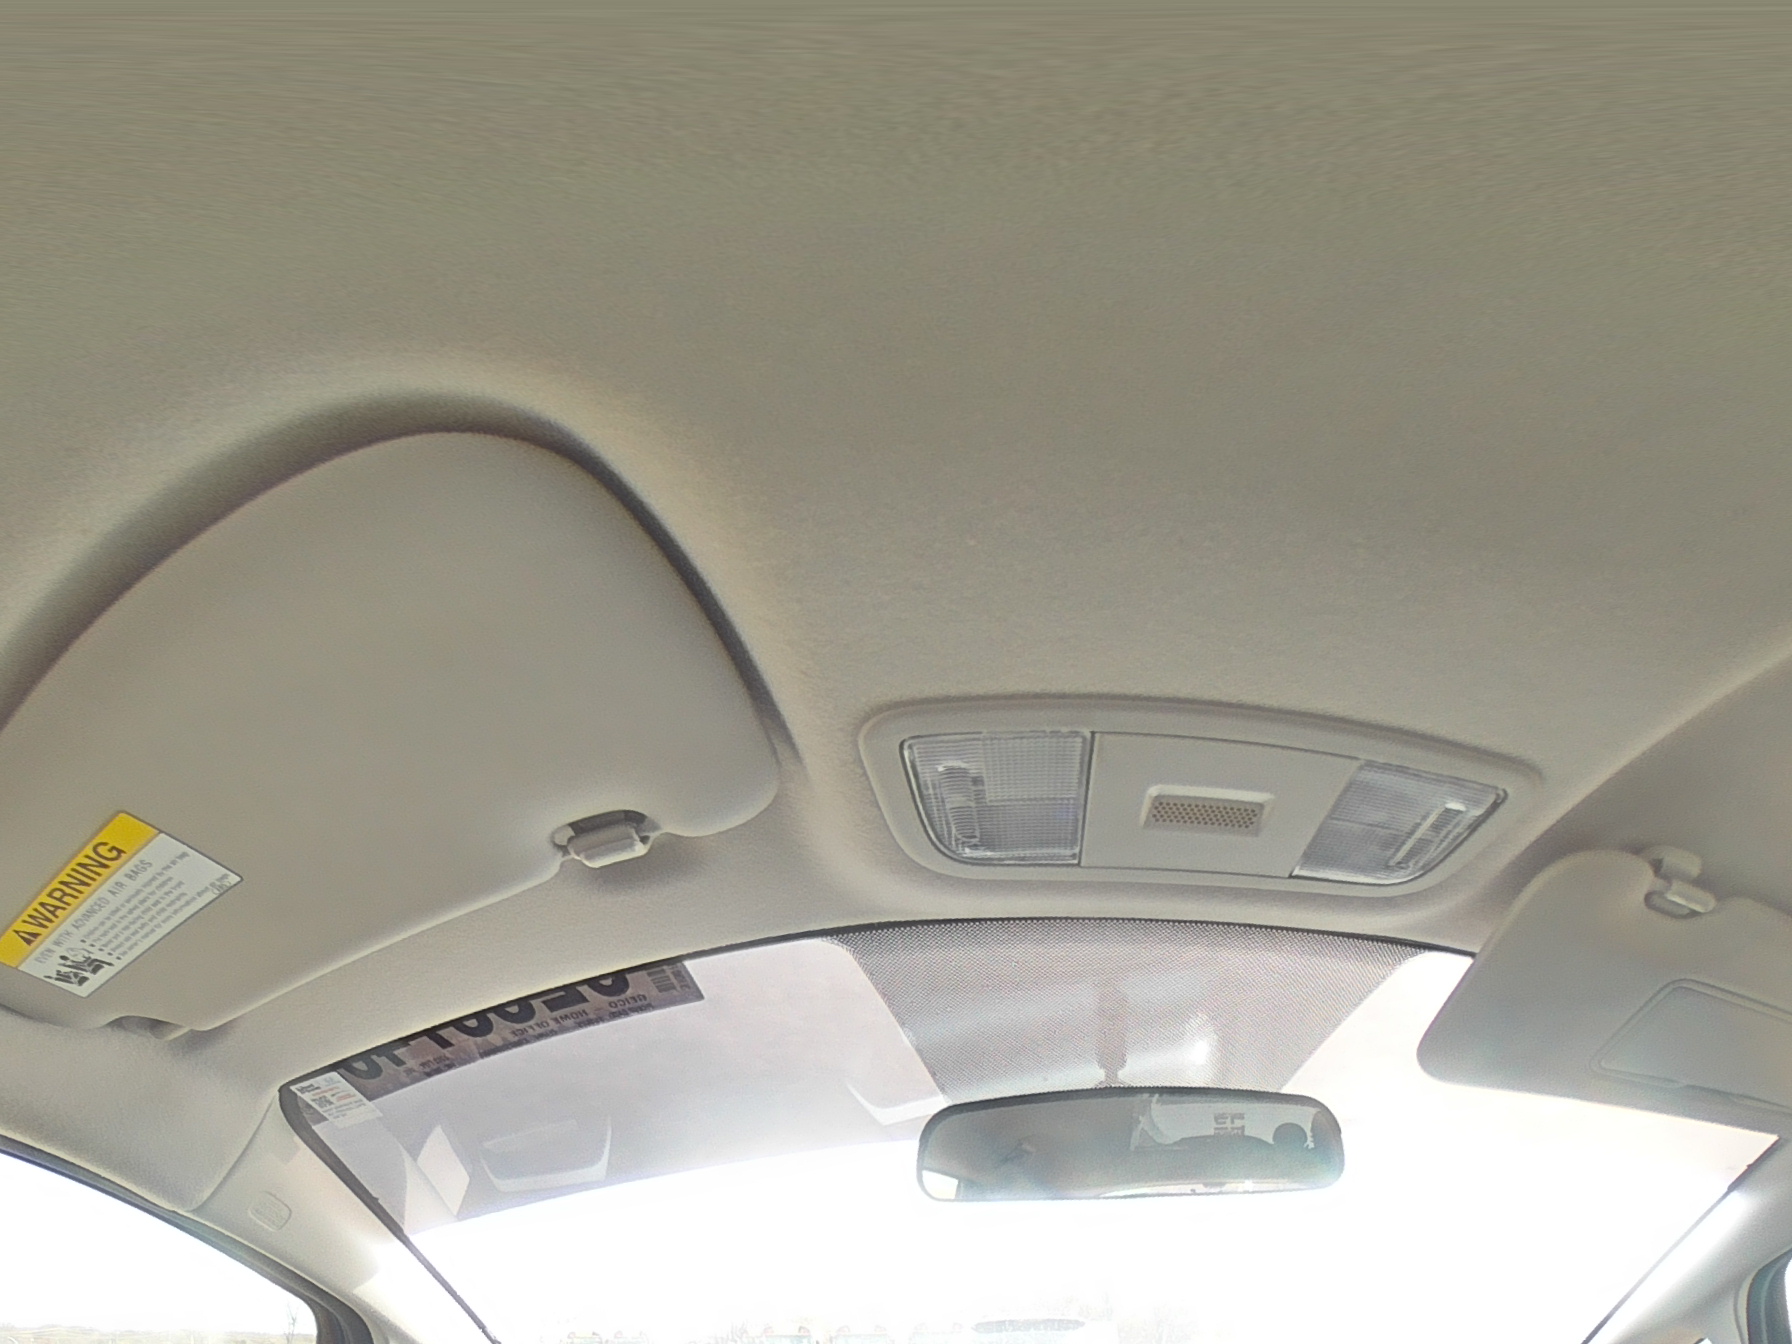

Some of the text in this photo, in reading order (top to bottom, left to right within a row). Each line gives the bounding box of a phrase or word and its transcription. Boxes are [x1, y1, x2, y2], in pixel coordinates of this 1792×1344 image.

[21, 841, 127, 929] WARNING
[108, 881, 127, 898] AIR
[124, 859, 153, 882] BAGS
